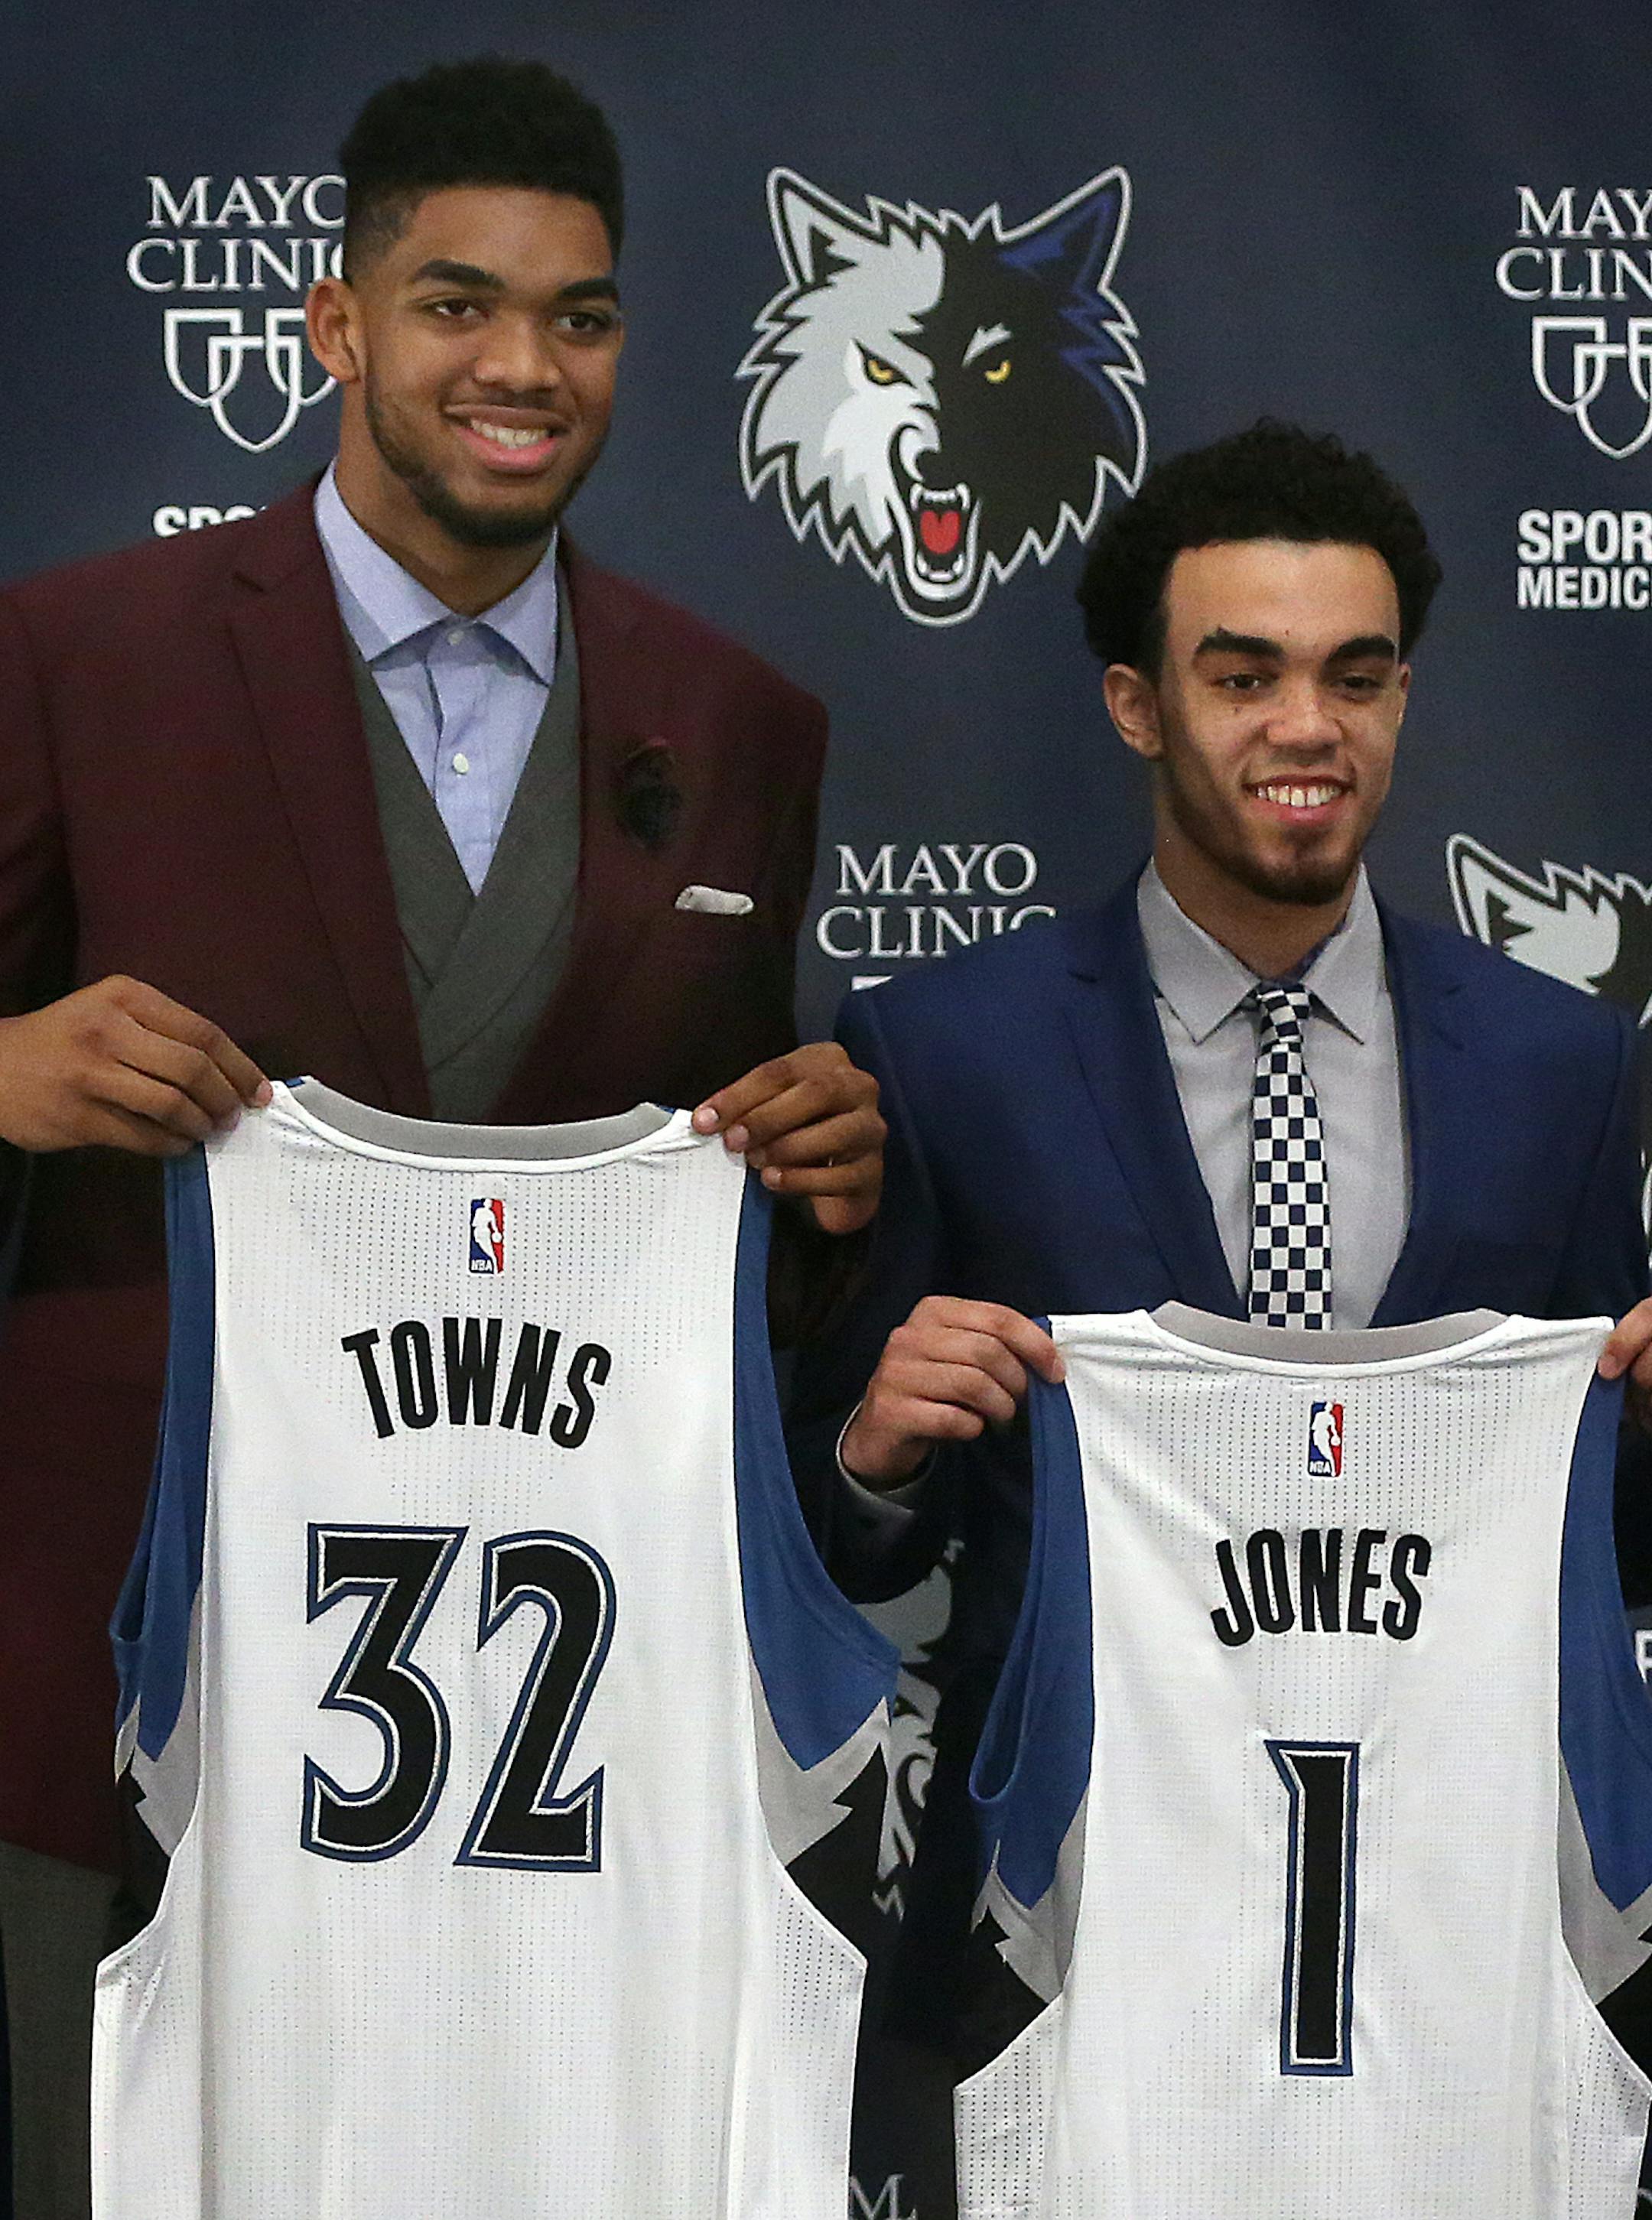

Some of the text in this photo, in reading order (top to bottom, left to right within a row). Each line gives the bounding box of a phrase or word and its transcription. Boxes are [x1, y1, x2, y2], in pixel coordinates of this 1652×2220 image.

[126, 237, 343, 293] CLINI
[1517, 509, 1652, 564] SPOR
[1517, 567, 1652, 609] MEDIC
[835, 843, 1037, 897] MAYO
[341, 1316, 613, 1449] TOWNS
[1211, 1528, 1432, 1646] JONES
[301, 1523, 616, 1873] 32
[1263, 1740, 1361, 2077] 1
